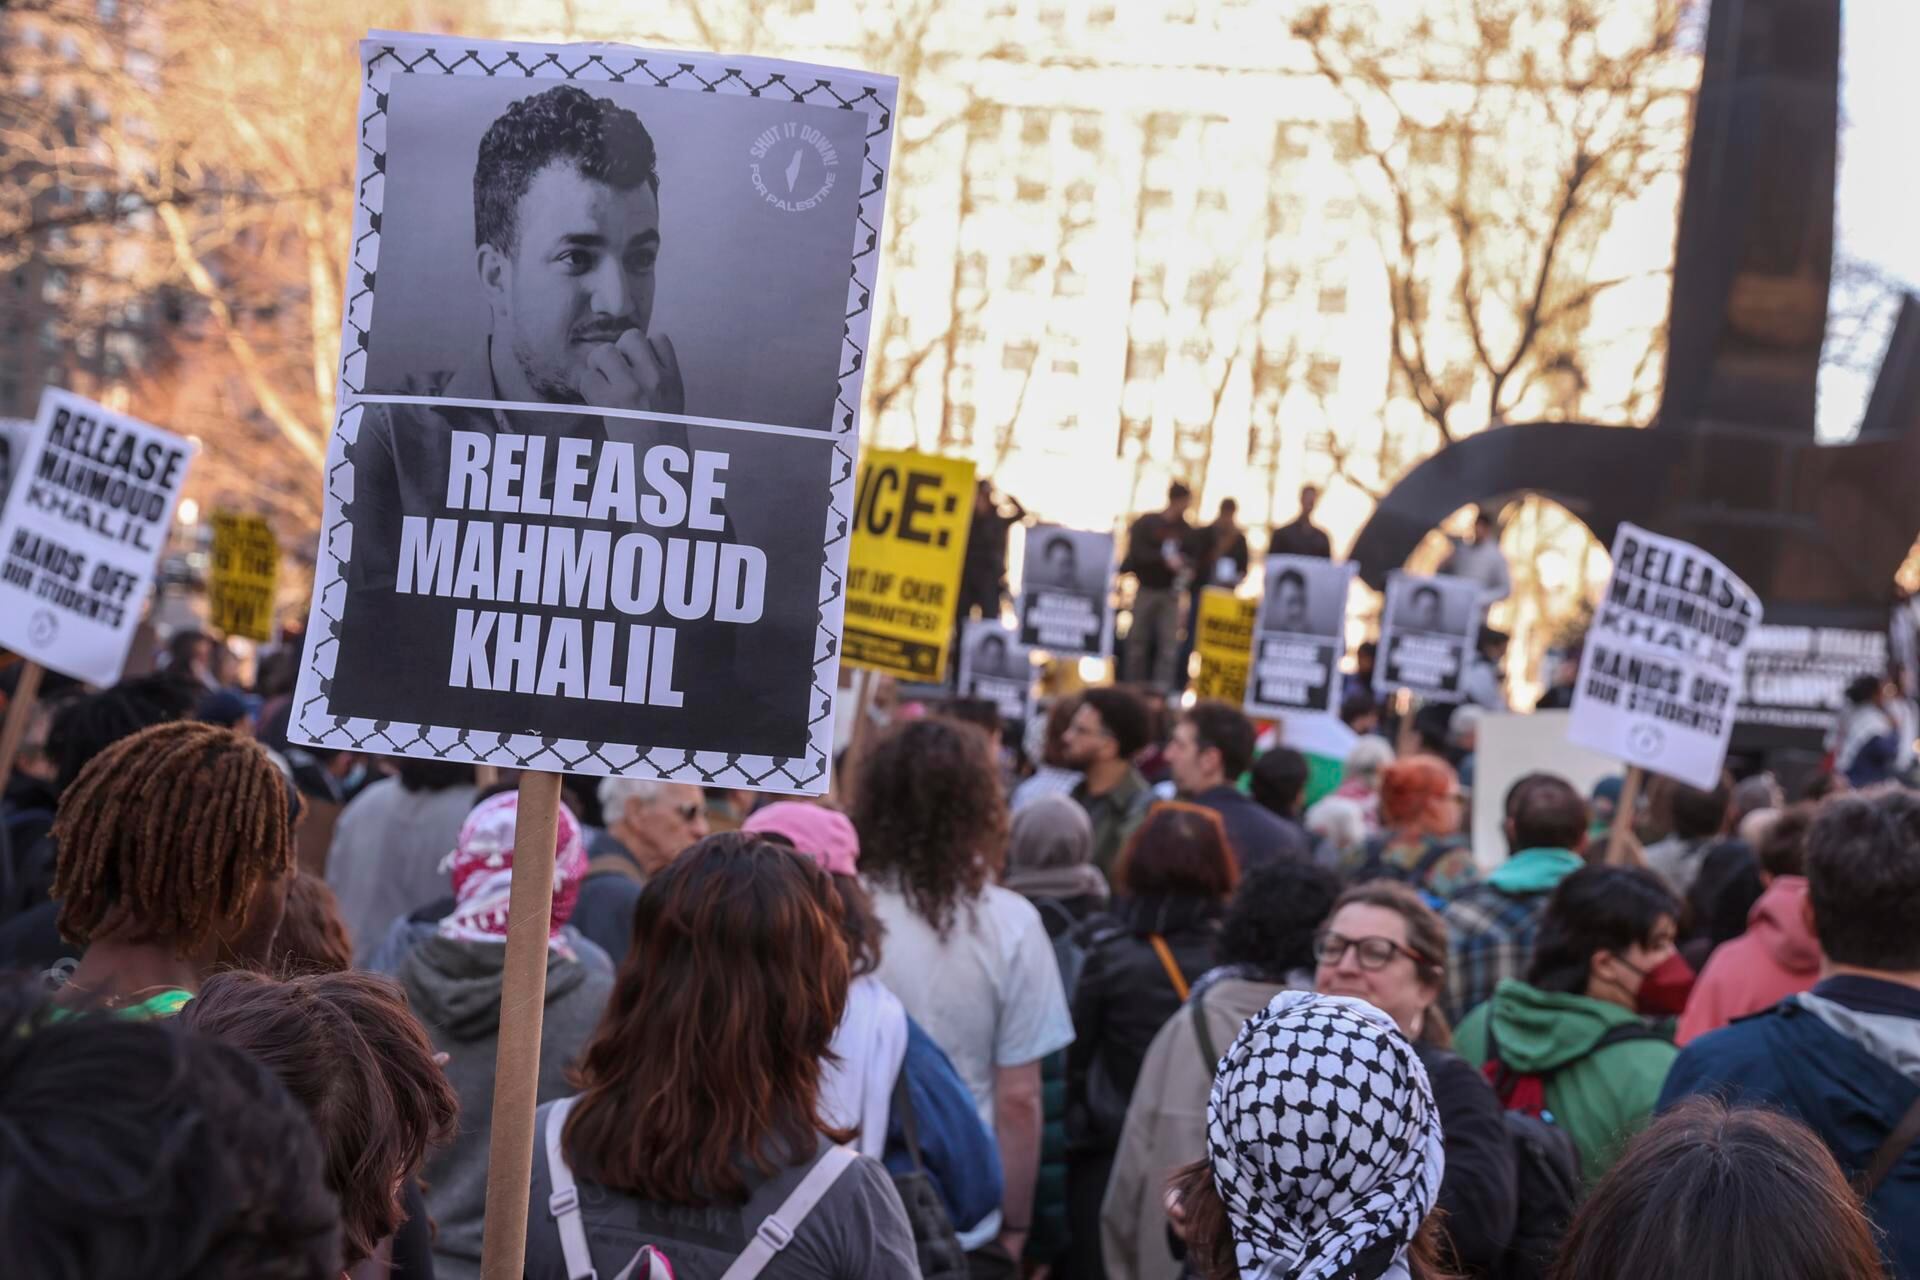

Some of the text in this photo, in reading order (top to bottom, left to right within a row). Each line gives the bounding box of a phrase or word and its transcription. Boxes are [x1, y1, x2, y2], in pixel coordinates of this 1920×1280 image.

[750, 122, 839, 166] SHUT IT DOWN!
[750, 164, 836, 212] FOR PALESTINE
[48, 407, 183, 489] RELEASE
[446, 430, 730, 532] RELEASE
[26, 484, 152, 552] KHALIL
[36, 450, 166, 523] MAHMOUD
[9, 527, 138, 601] HANDS OFF
[396, 516, 767, 624] MAHMOUD
[847, 566, 867, 590] UT
[449, 609, 684, 708] KHALIL
